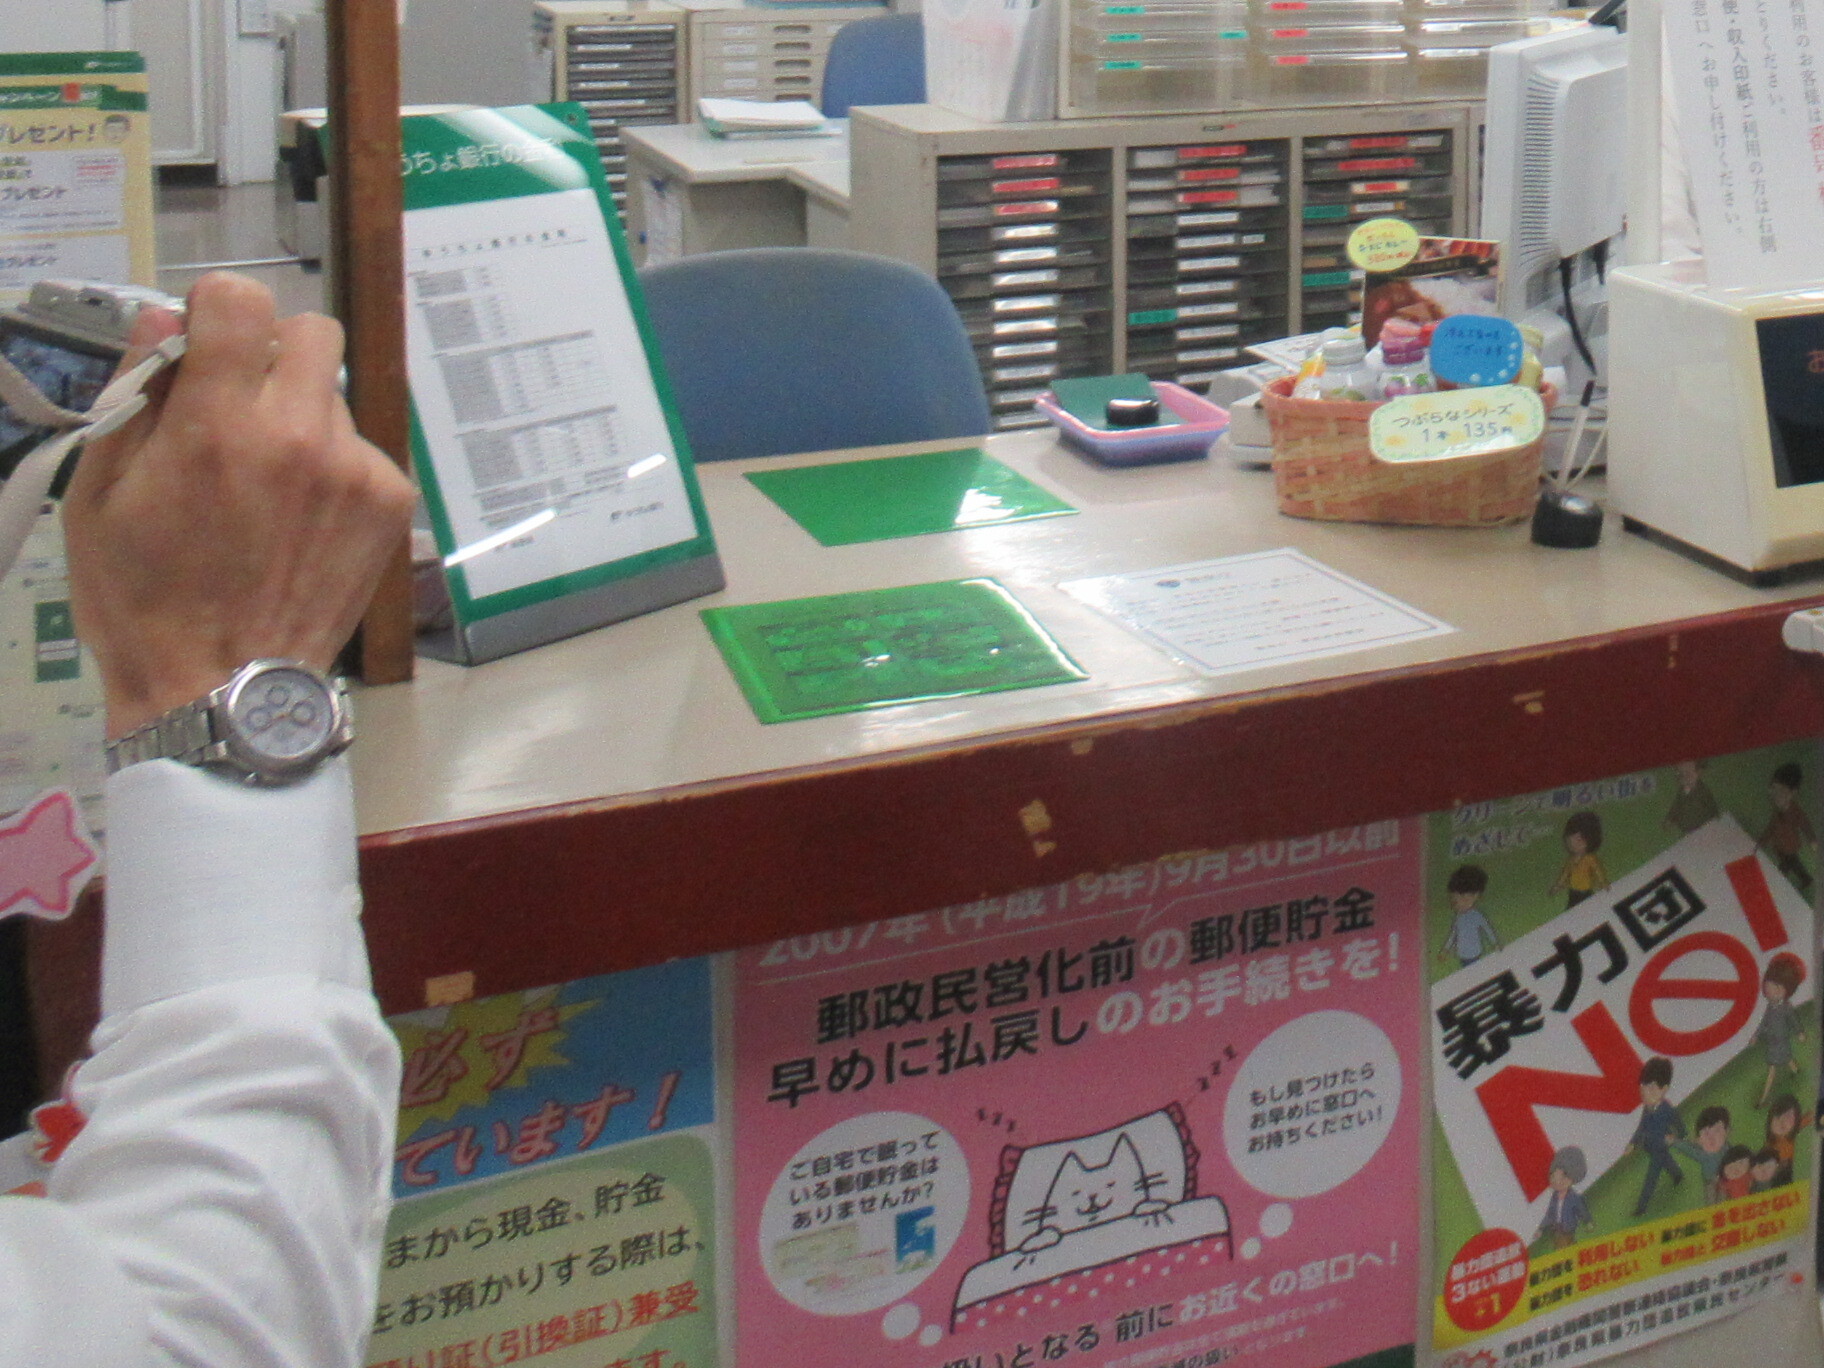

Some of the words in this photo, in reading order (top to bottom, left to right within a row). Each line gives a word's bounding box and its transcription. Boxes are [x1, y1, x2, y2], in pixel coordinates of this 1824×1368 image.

[401, 136, 562, 177] うちょ銀行の金
[1391, 402, 1515, 429] つぶらなシリーズ
[816, 885, 1377, 1044] 郵政民営化前の郵便貯金
[1436, 866, 1707, 1081] 暴力団
[767, 931, 1401, 1109] 早めに払戻しのお手続きを!
[1250, 1060, 1377, 1107] もし見つけたら
[1250, 1088, 1377, 1131] お早めに窓口へ
[1247, 1103, 1384, 1155] お持ちください!
[788, 1130, 943, 1182] ご自宅で眠って
[788, 1155, 941, 1207] いる郵便貯金は
[386, 1172, 666, 1270] まから現金、貯金
[791, 1180, 936, 1231] ありませんか?
[366, 1280, 701, 1368] り証(引換証)兼受
